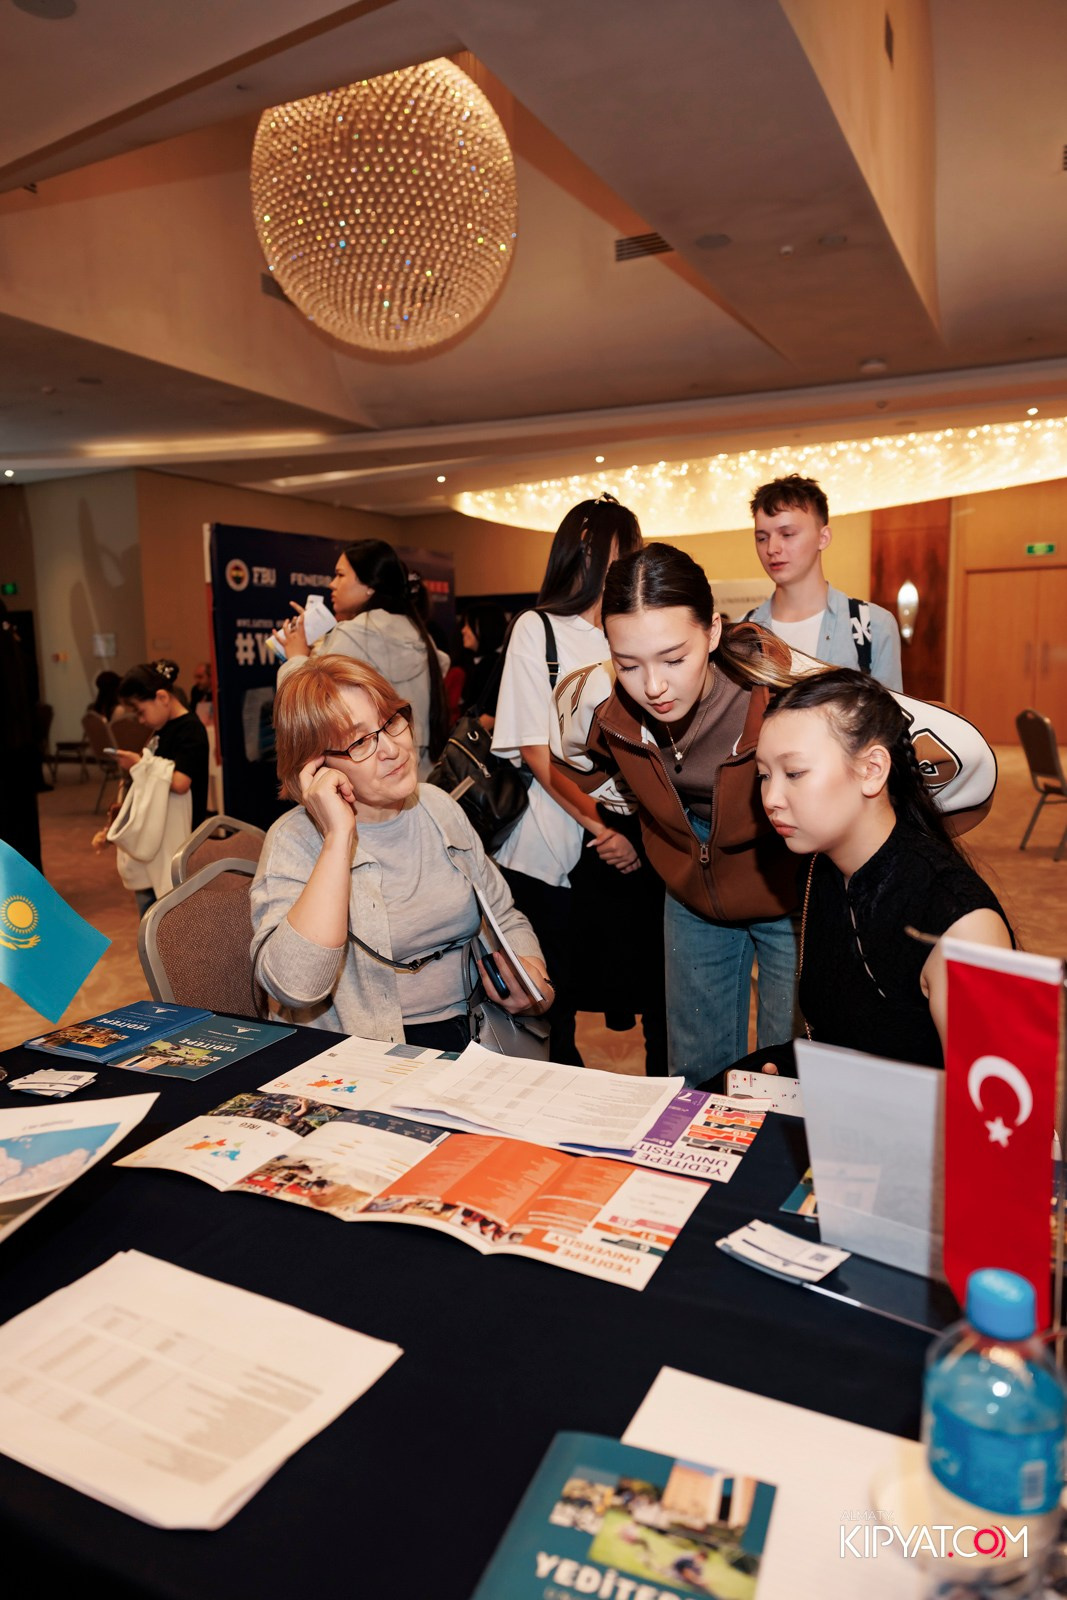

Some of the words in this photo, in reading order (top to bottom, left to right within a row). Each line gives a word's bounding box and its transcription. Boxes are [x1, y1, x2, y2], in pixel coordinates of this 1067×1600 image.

[638, 1153, 723, 1176] YEDİTEPE
[549, 1234, 642, 1266] UNIVERSITY
[560, 1248, 634, 1277] YEDİTEPE
[535, 1550, 696, 1600] YEDİTE
